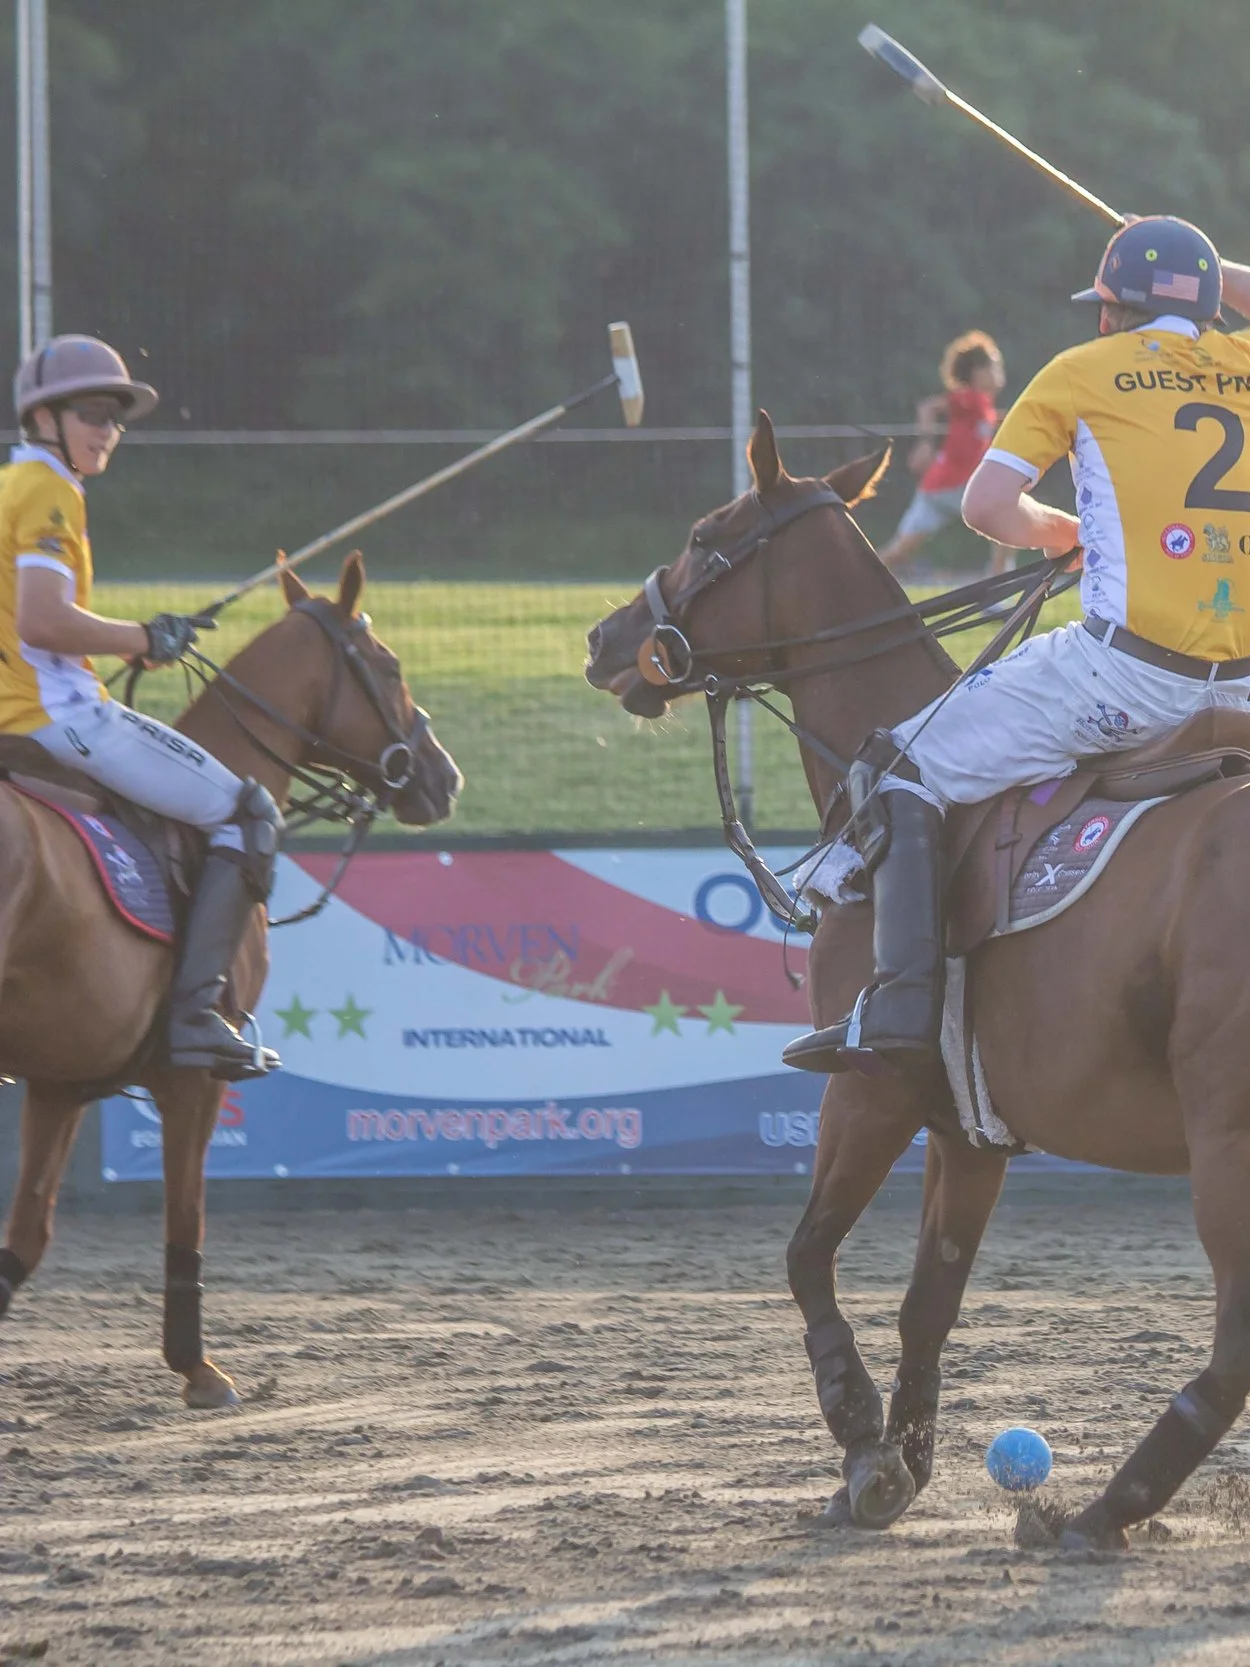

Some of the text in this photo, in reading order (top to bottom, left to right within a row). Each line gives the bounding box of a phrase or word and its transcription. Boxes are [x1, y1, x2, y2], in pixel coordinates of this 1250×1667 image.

[1114, 370, 1207, 392] GUEST
[383, 924, 579, 966] MORVEN
[402, 1028, 612, 1049] INTERNATIONAL
[347, 1101, 643, 1149] morvenpark.org
